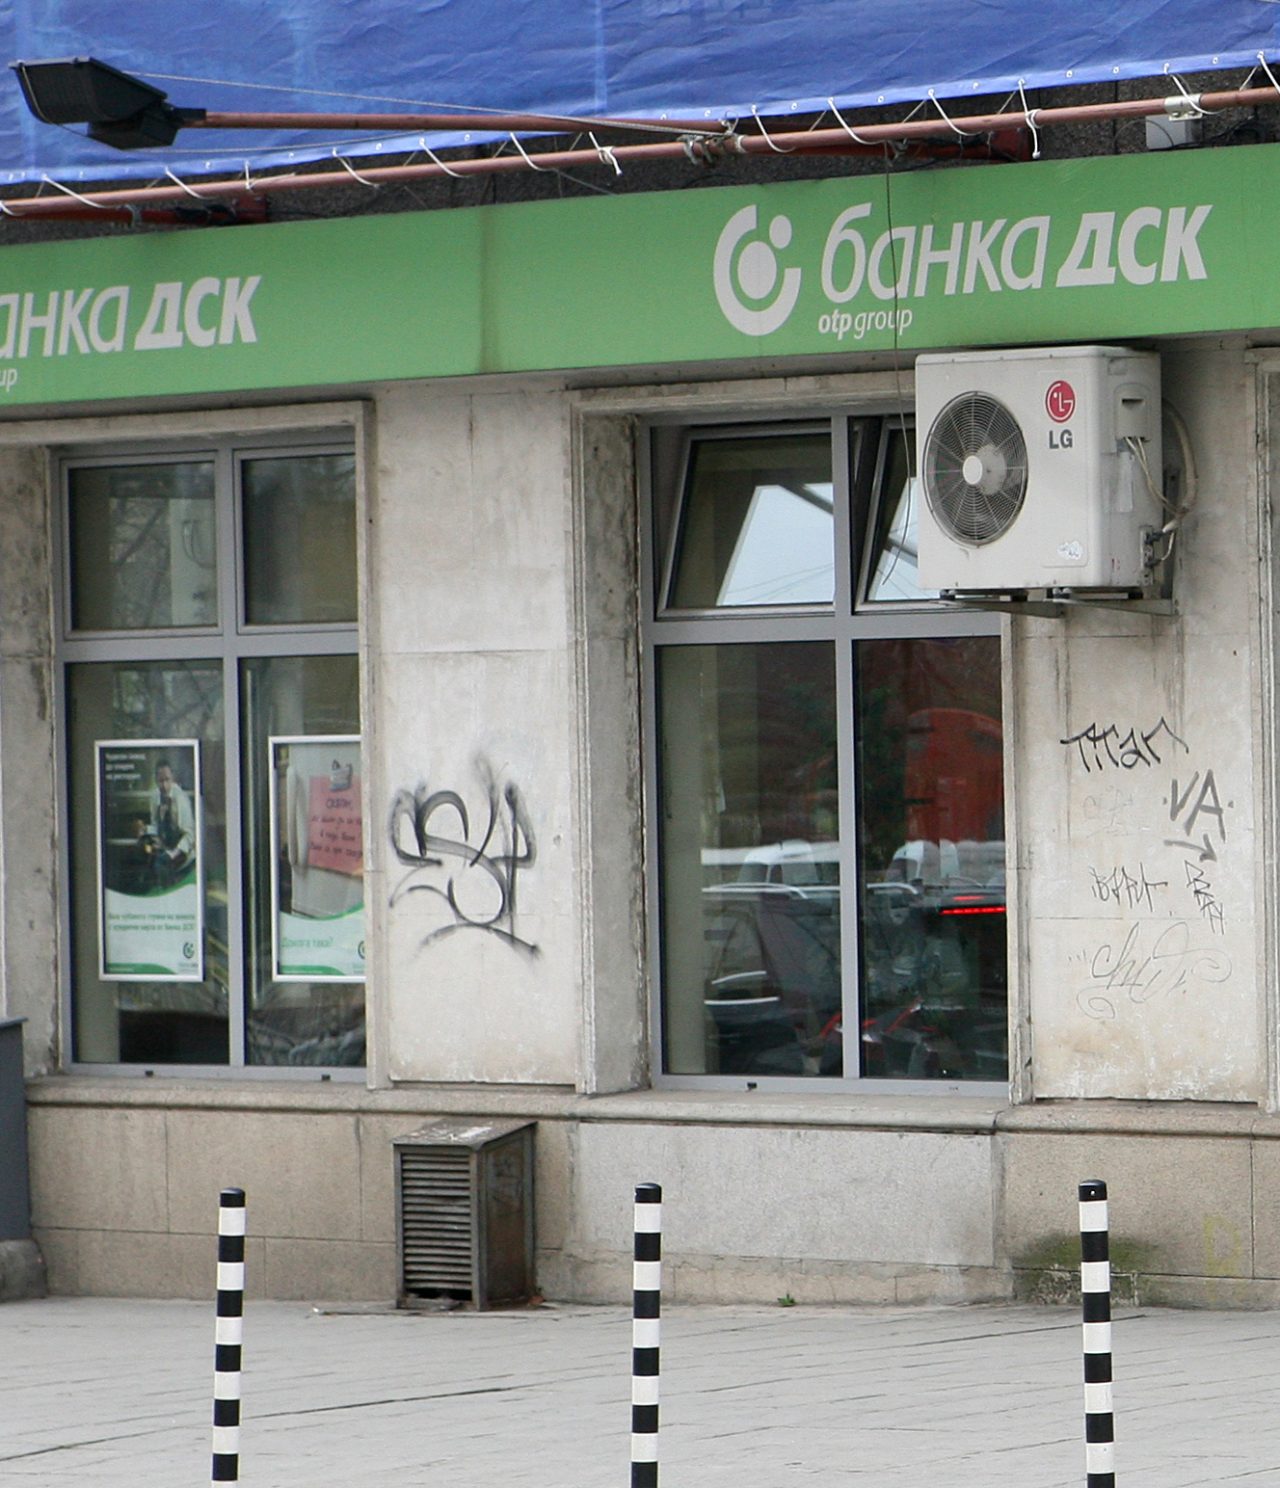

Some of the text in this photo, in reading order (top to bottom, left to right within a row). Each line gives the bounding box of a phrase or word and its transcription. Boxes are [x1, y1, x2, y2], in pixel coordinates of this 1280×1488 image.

[820, 202, 1214, 304] банка ДСК
[134, 275, 262, 351] ДСК
[1049, 429, 1073, 449] LG
